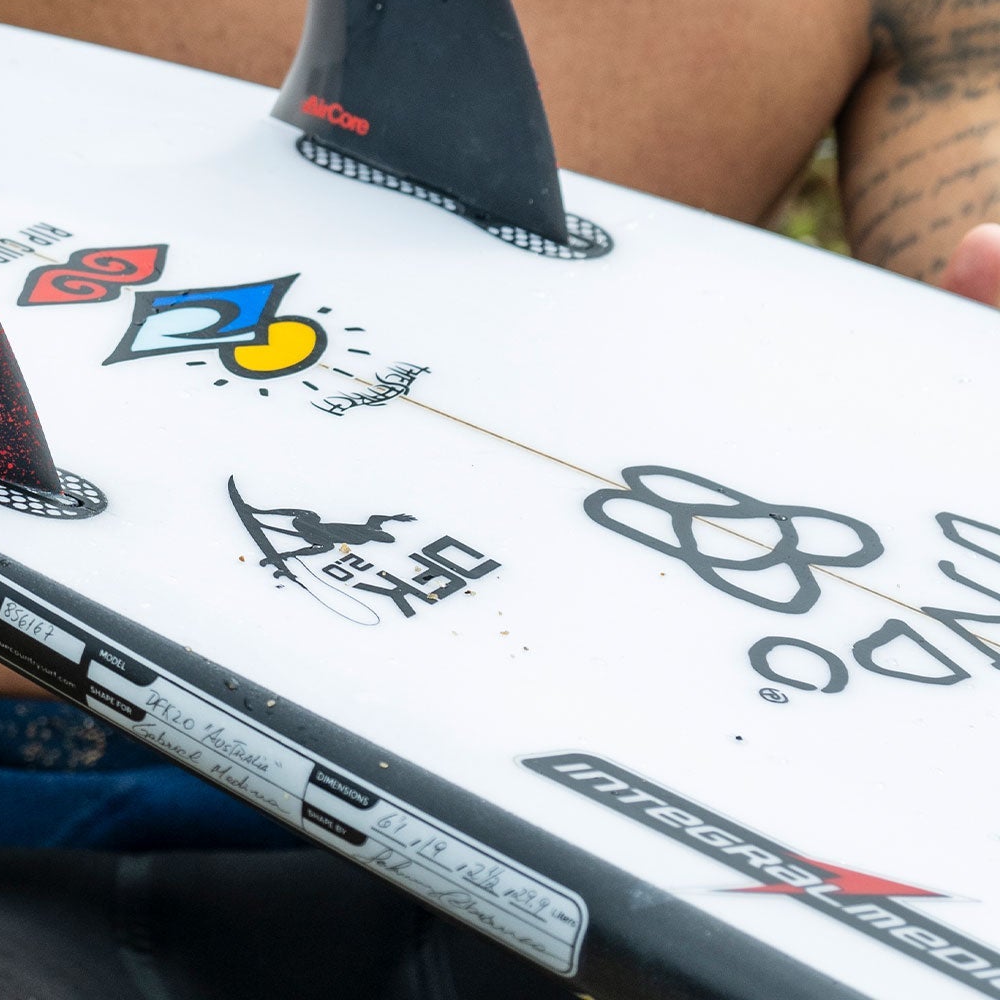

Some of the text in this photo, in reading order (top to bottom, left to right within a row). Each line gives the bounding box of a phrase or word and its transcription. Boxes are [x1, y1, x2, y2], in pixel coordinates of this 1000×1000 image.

[302, 94, 371, 136] AirCore
[19, 222, 73, 247] RIP
[322, 553, 375, 582] 2.0
[352, 535, 501, 619] DFK
[3, 602, 55, 641] 856167
[99, 649, 126, 671] MODEL
[89, 685, 133, 716] SHAPE FOR
[132, 723, 292, 815] Gabriel Medina
[316, 771, 370, 807] DIMENSIONS
[307, 809, 348, 837] SHAPE BY
